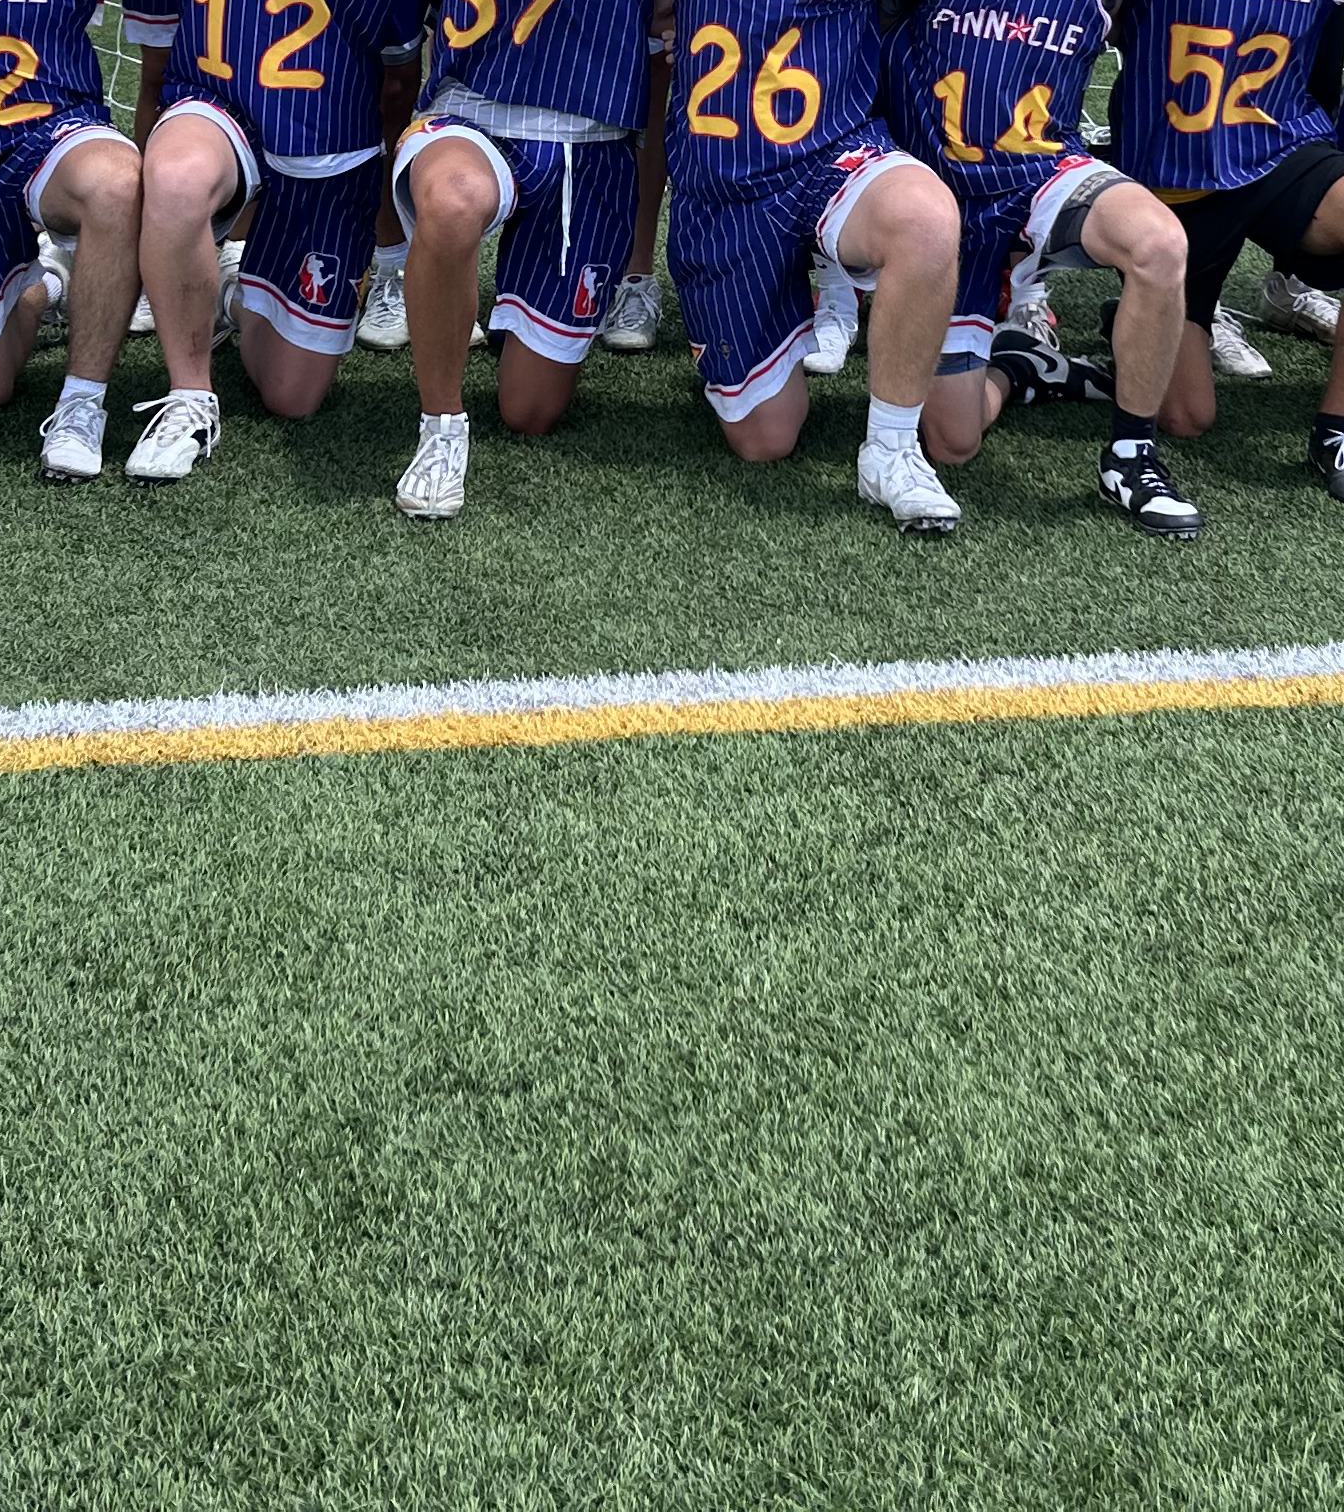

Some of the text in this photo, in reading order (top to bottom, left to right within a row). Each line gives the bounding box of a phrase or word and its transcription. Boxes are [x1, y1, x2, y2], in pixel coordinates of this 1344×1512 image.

[688, 23, 821, 146] 26
[933, 70, 1064, 163] 14
[1165, 23, 1291, 134] 52
